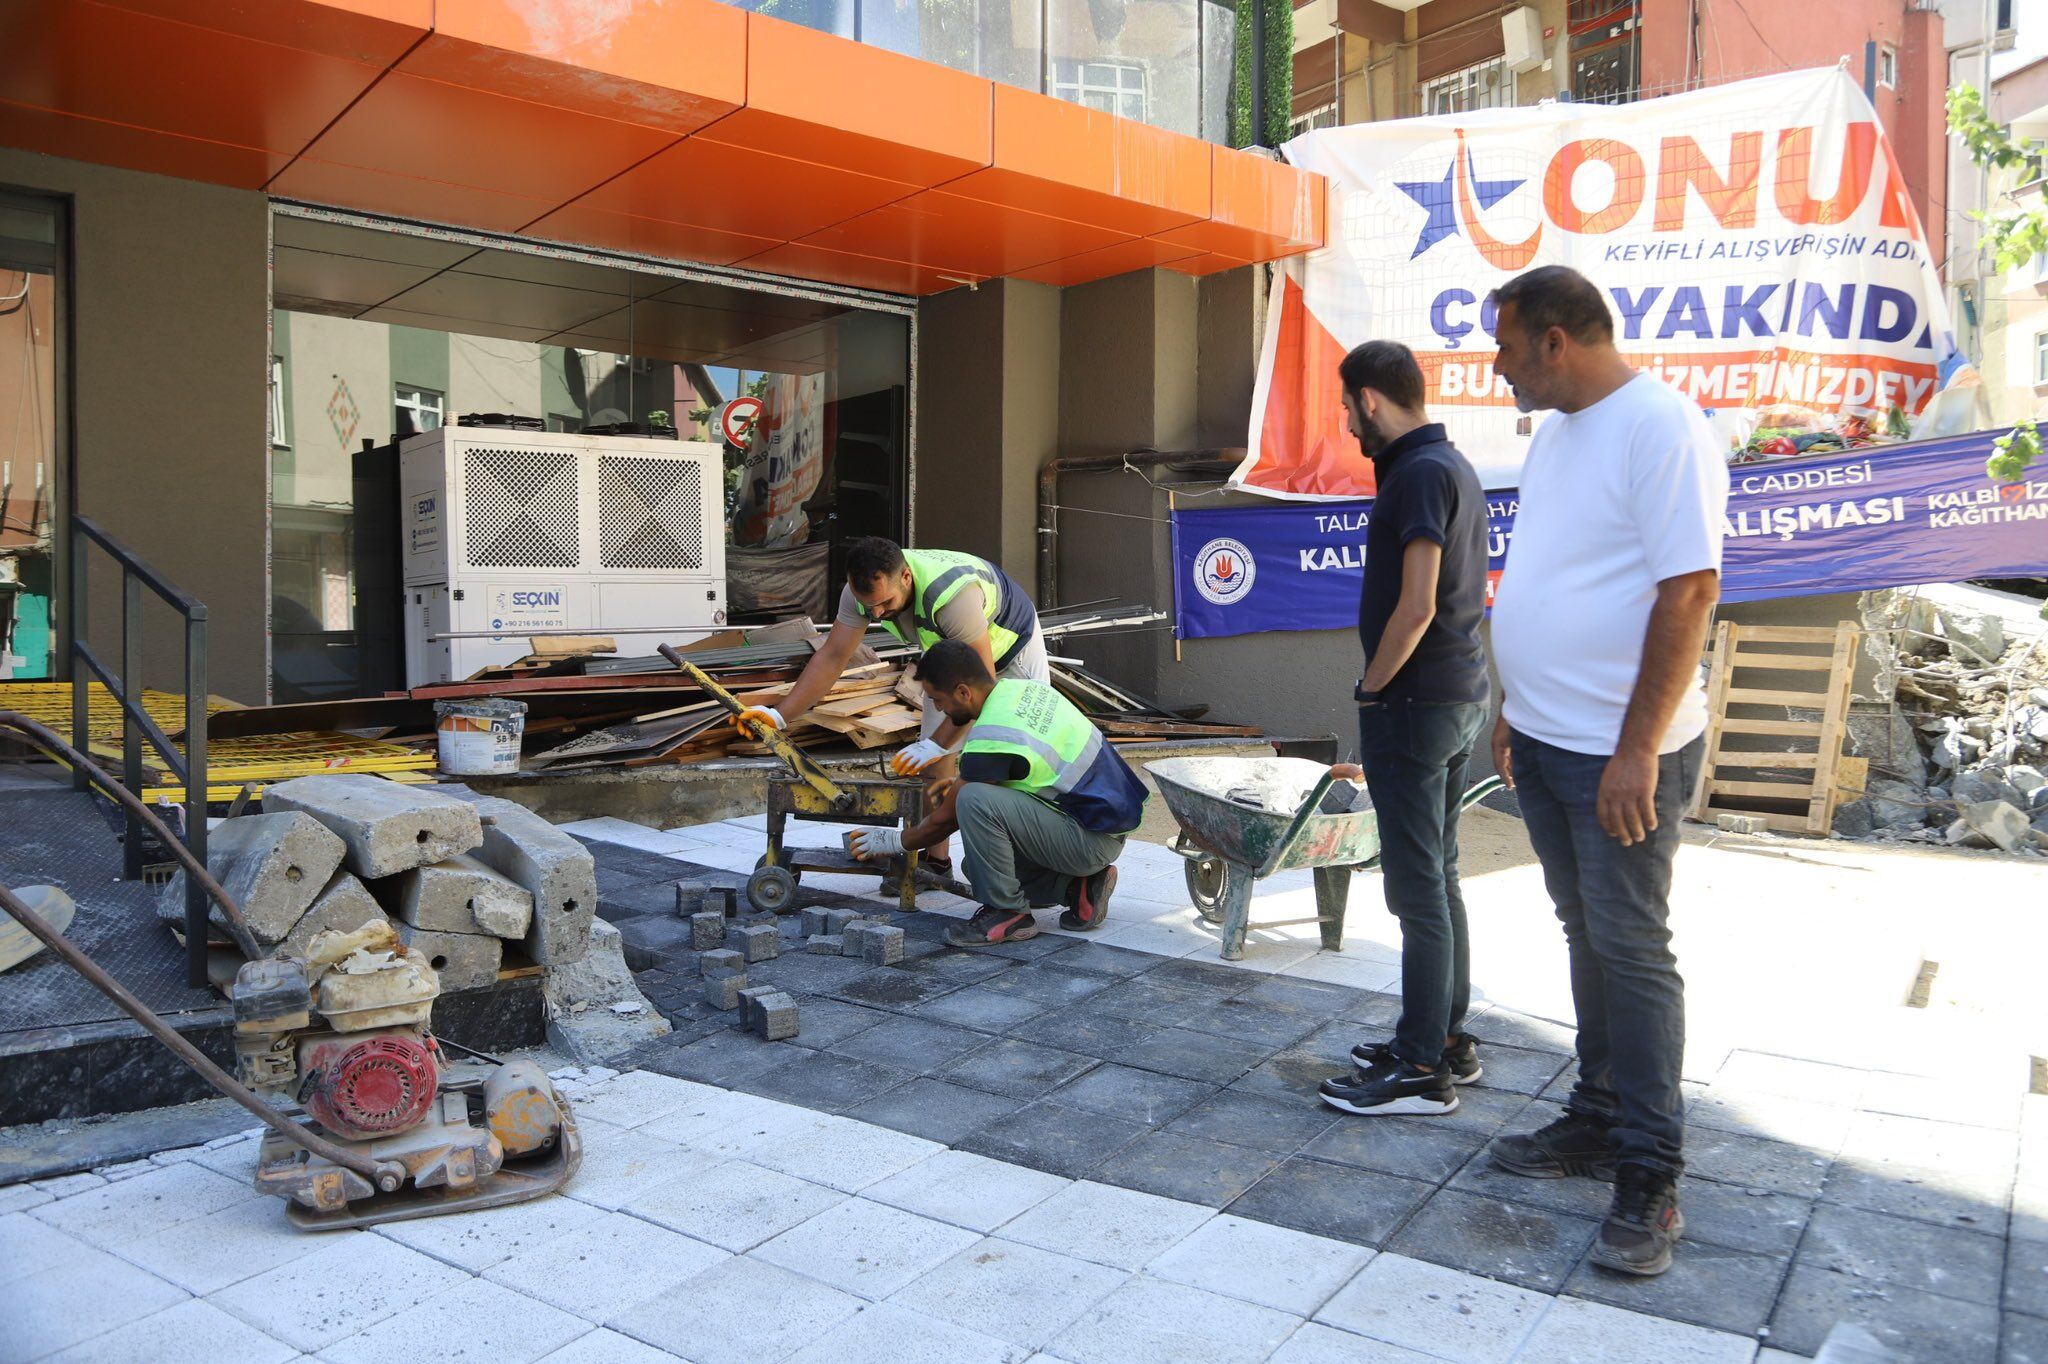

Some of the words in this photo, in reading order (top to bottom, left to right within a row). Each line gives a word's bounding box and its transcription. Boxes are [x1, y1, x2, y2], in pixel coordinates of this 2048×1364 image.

[1604, 238, 1705, 262] KEYİFLİ
[1709, 233, 1867, 262] ALIŞVERİŞİN
[1742, 460, 1873, 495] CADDESİ
